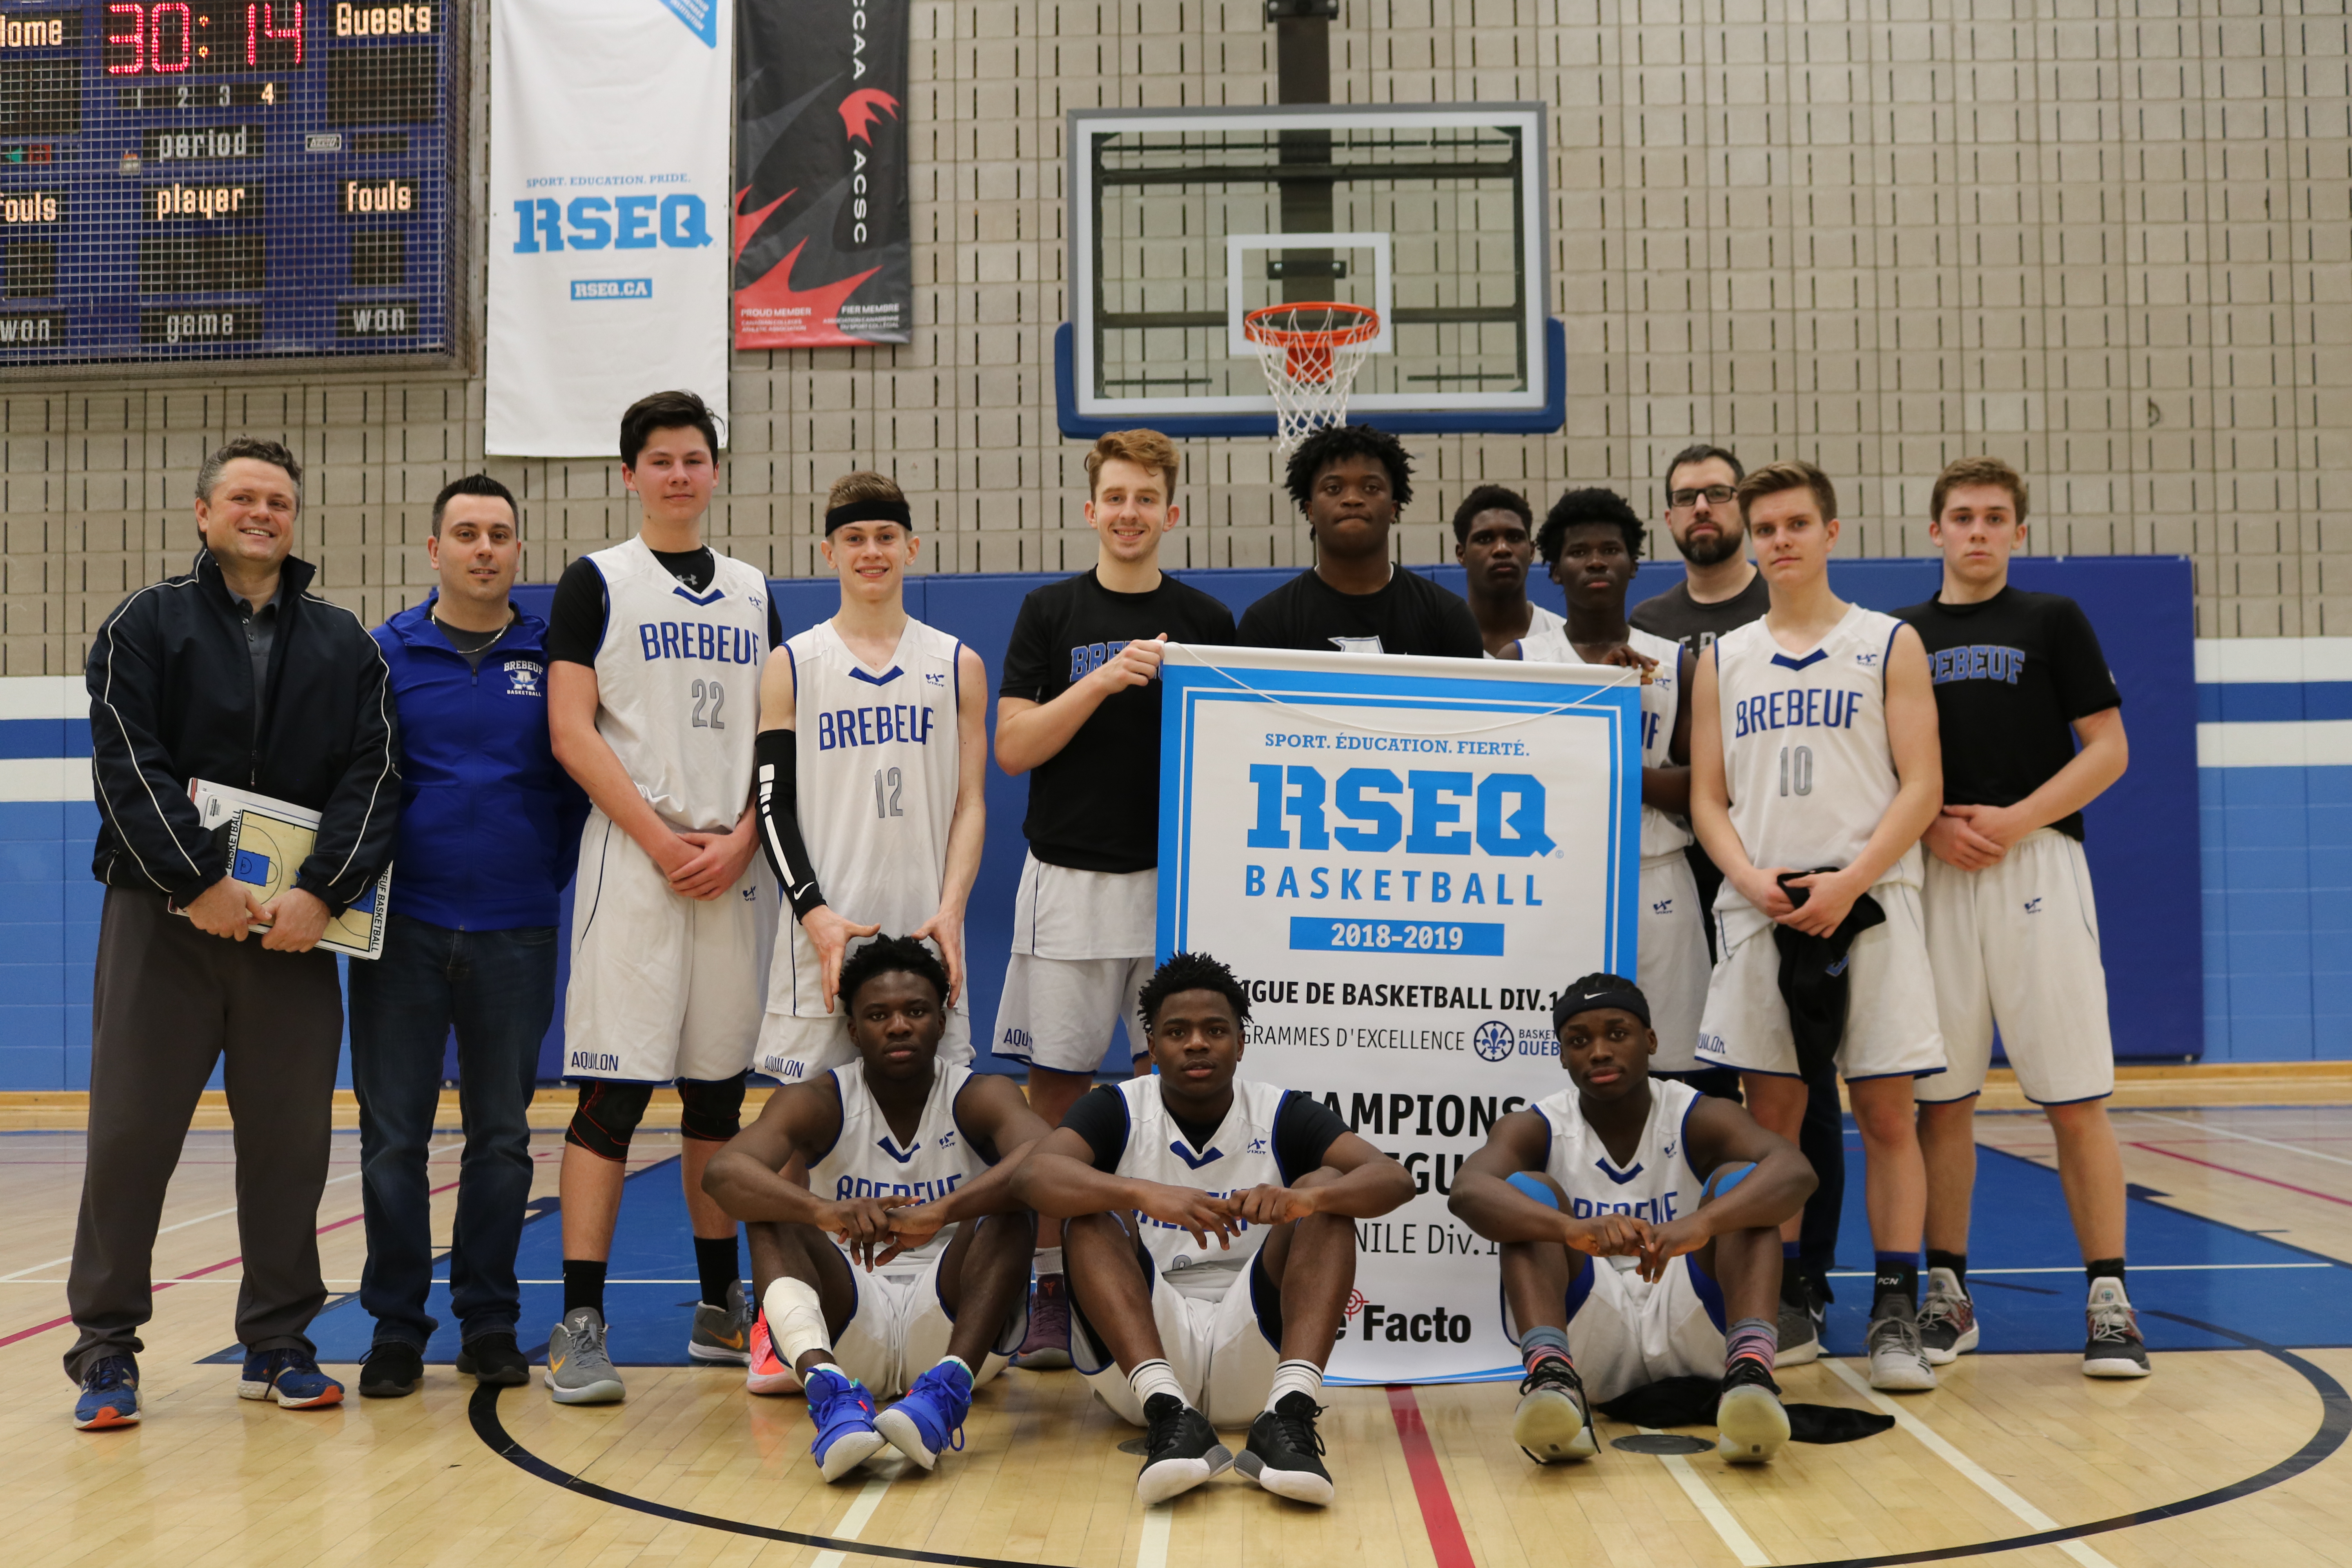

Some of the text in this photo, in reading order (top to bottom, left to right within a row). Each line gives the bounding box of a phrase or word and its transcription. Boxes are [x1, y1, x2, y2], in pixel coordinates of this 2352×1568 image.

[337, 3, 431, 36] Guests
[137, 82, 274, 109] 1 2 3 4
[160, 125, 246, 163] period
[526, 173, 691, 188] SPORT. EDUCATION. PRIDE.
[158, 183, 245, 221] player
[347, 180, 411, 212] fouls
[853, 149, 867, 243] ACSC
[514, 194, 713, 254] RSEQ
[574, 281, 648, 298] RSEQ.CA
[353, 307, 405, 332] won
[740, 307, 811, 317] PROUD MEMBER
[841, 303, 900, 314] FIER MEMBRE
[0, 318, 50, 342] won
[167, 313, 233, 343] game
[639, 621, 759, 667] BREBEUF
[503, 660, 543, 675] BREBEUF
[691, 679, 725, 729] 22
[1735, 688, 1863, 739] BREBEUF
[819, 704, 934, 751] BREBEUF
[1265, 733, 1530, 757] SPORT. ÉDUCATION. FIERTÉ.
[1780, 745, 1813, 797] 10
[874, 767, 903, 818] 12
[1247, 763, 1557, 858] RSEQ
[1245, 865, 1543, 906] BASKETBALL
[371, 894, 385, 952] BASKETBALL
[1331, 923, 1463, 951] 2018-2019
[1242, 980, 1299, 1004] IGUE
[1306, 982, 1335, 1005] DE
[1343, 984, 1493, 1010] BASKETBALL
[1244, 1025, 1465, 1051] GRAMMES D'EXCELLENCE
[1519, 1029, 1556, 1039] BASKET
[1519, 1039, 1561, 1056] QUÉB
[571, 1051, 619, 1072] AQUILON
[764, 1054, 805, 1079] AQUILON
[1356, 1223, 1416, 1254] NILE
[1363, 1305, 1472, 1343] Facto
